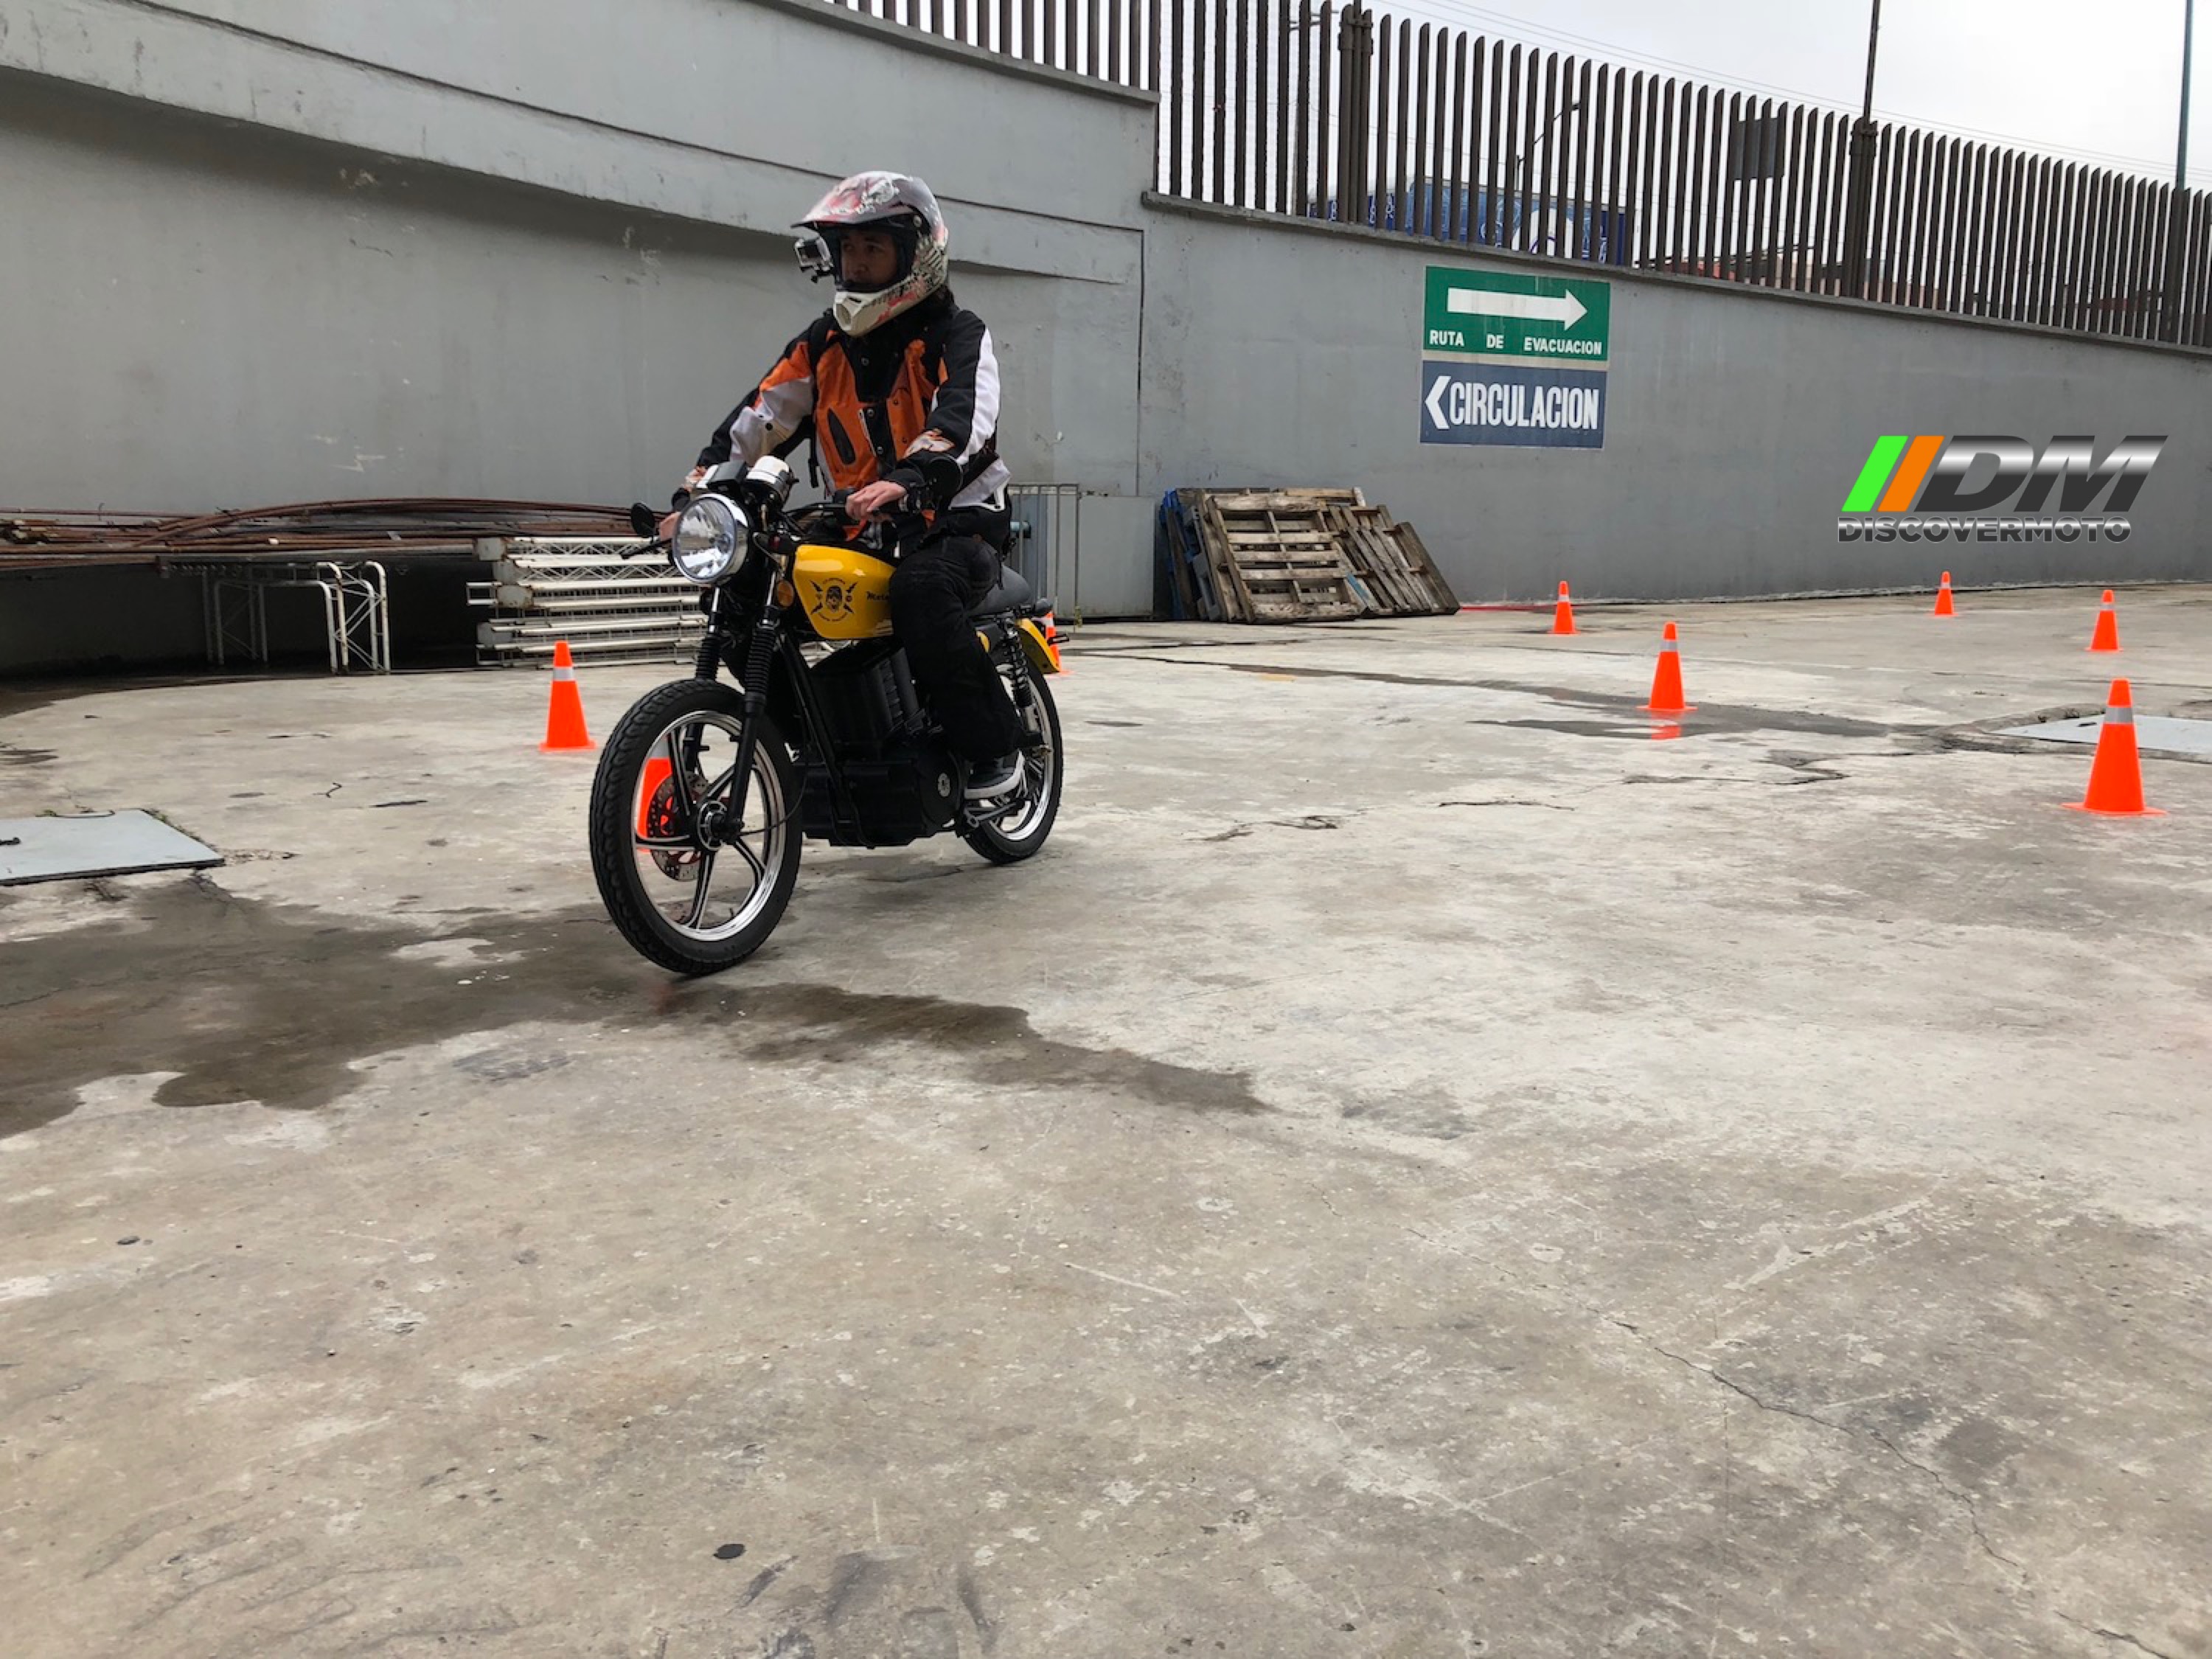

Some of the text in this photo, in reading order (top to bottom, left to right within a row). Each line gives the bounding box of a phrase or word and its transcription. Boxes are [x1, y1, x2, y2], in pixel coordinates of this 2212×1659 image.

[1430, 330, 1602, 355] RUTA DE EVACUACION
[1449, 381, 1599, 430] CIRCULACION
